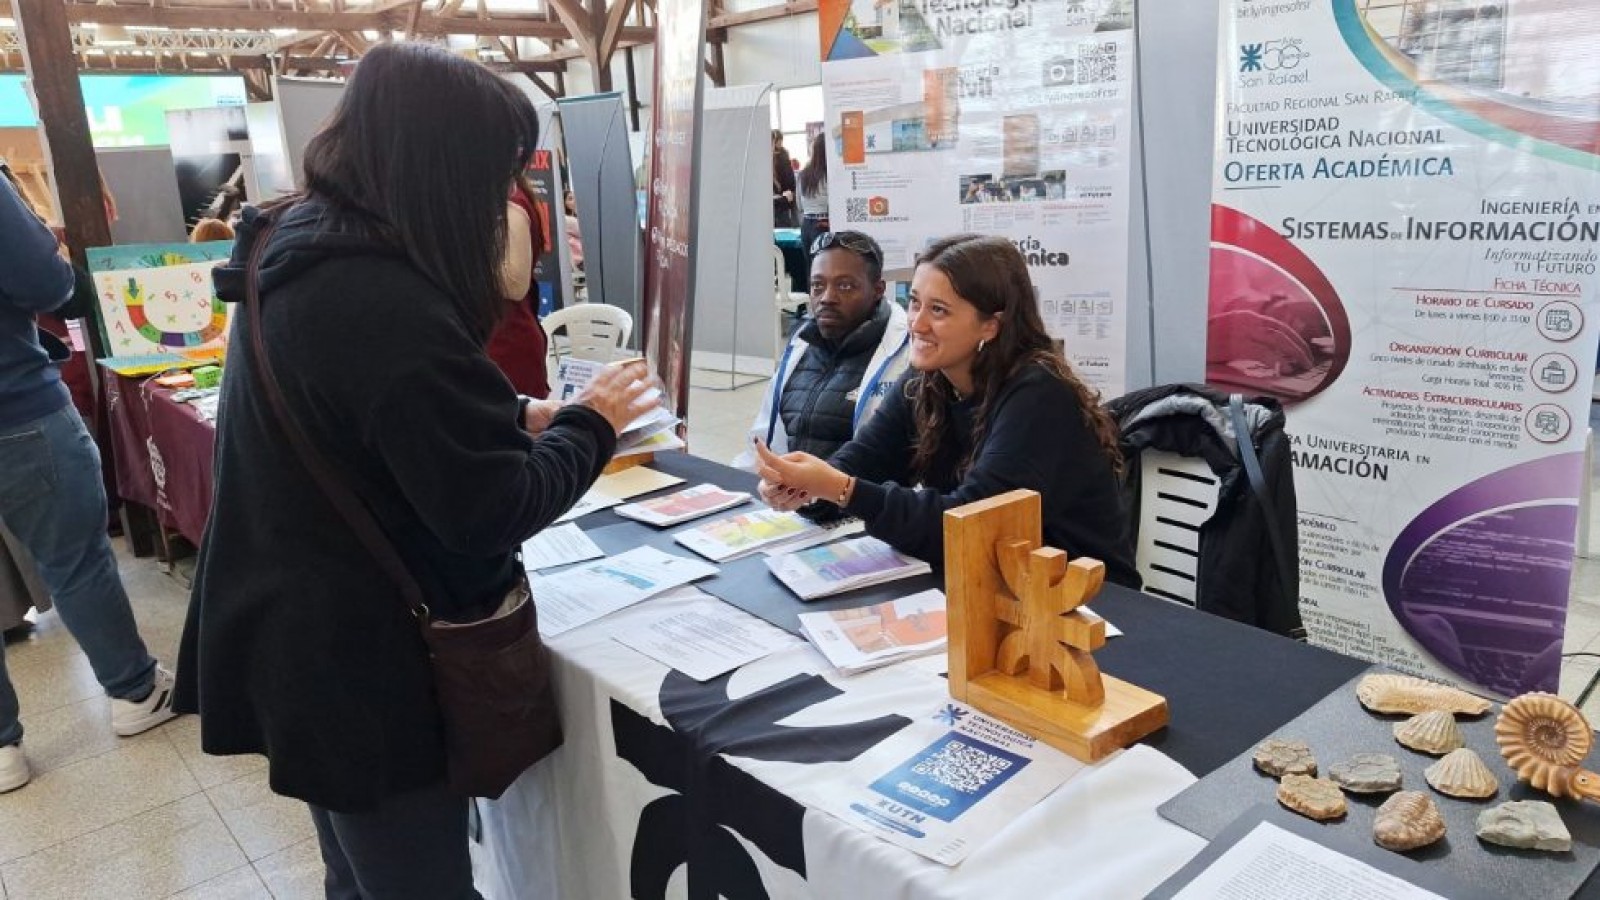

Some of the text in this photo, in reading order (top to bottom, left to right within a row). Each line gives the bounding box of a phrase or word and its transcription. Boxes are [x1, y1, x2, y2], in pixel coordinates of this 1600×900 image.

[937, 5, 1033, 36] Nacional
[1284, 97, 1340, 110] REGIONAL
[1345, 92, 1368, 105] SAN
[1228, 117, 1340, 136] UNIVERSIDAD
[1226, 129, 1446, 154] TECNOLÓGICA NACIONAL
[1224, 153, 1454, 182] OFERTA ACADÉMICA
[1481, 196, 1580, 215] INGENIERÍA
[1282, 216, 1389, 240] SISTEMAS
[1406, 213, 1600, 242] INFORMACIÓN
[1484, 248, 1598, 264] Informatizando
[1514, 260, 1596, 275] TU FUTURO
[1494, 277, 1581, 293] FICHA TÉCNICA
[1416, 295, 1534, 310] HORARIO DE CURSADO
[1389, 341, 1529, 362] ORGANIZACIÓN CURRICULAR
[1307, 434, 1410, 462] UNIVERSITARIA
[1416, 454, 1431, 465] EN
[1291, 450, 1389, 481] AMACIÓN
[888, 803, 926, 823] UTN
